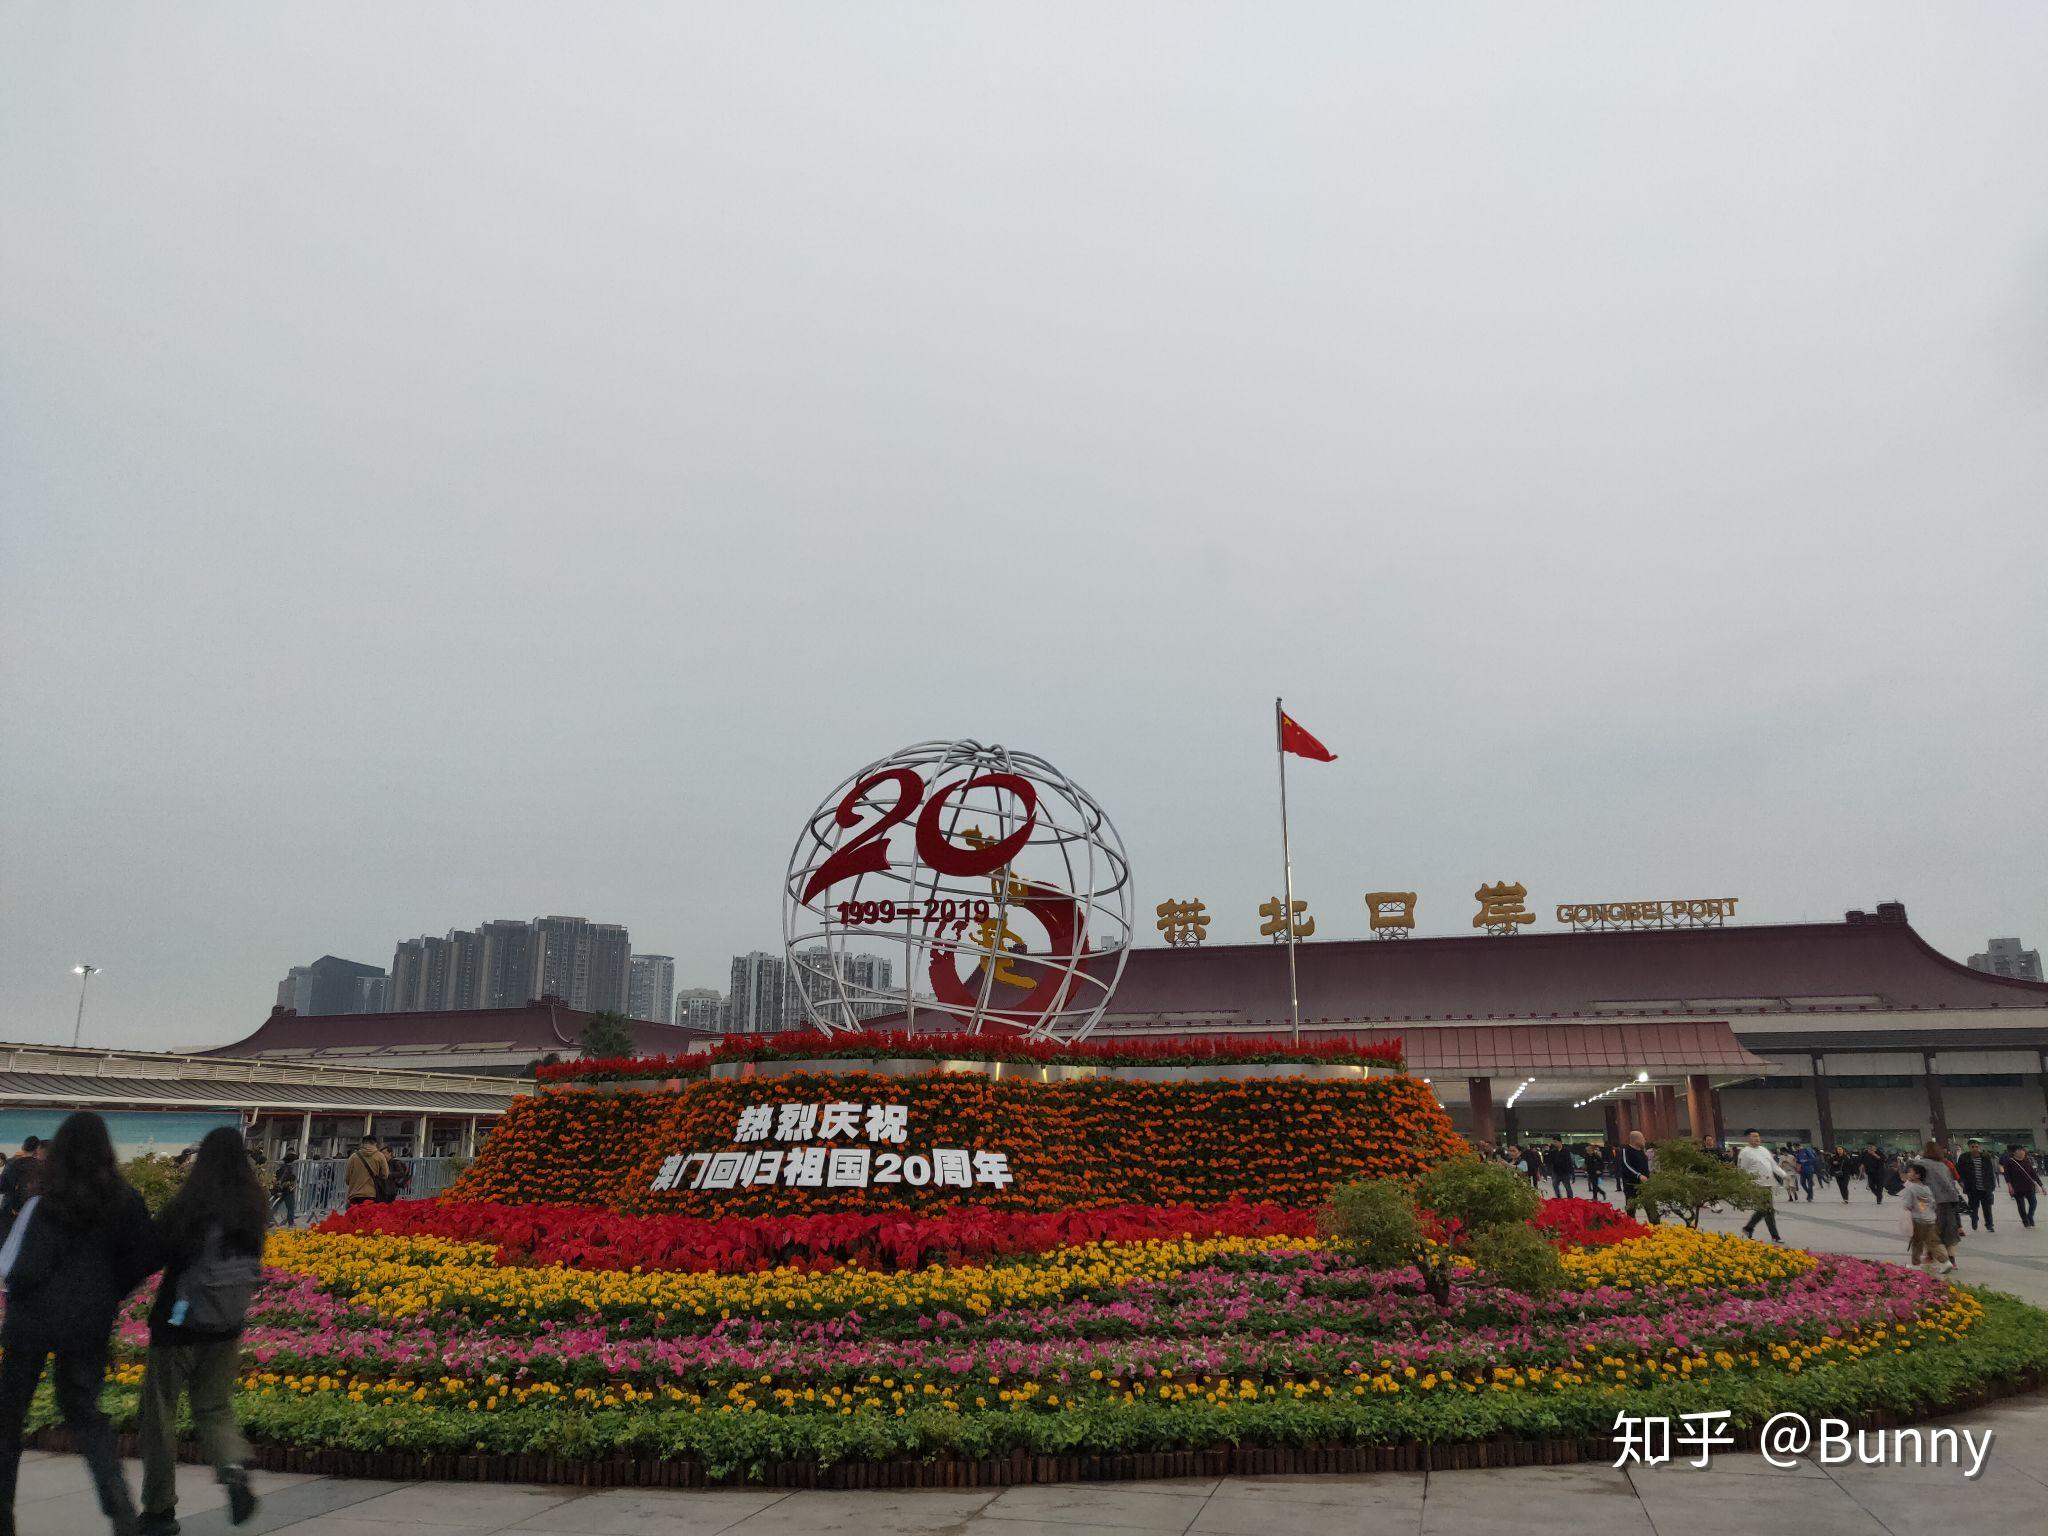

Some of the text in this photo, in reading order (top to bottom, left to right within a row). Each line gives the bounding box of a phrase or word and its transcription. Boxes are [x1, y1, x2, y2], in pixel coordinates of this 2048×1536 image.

[801, 768, 1037, 905] 20
[1156, 881, 1536, 943] 拱北口岸
[1556, 898, 1738, 923] GONGBEI PORT
[733, 1102, 908, 1143] 热烈庆祝
[650, 1148, 1013, 1191] 澳门回归祖国20周年
